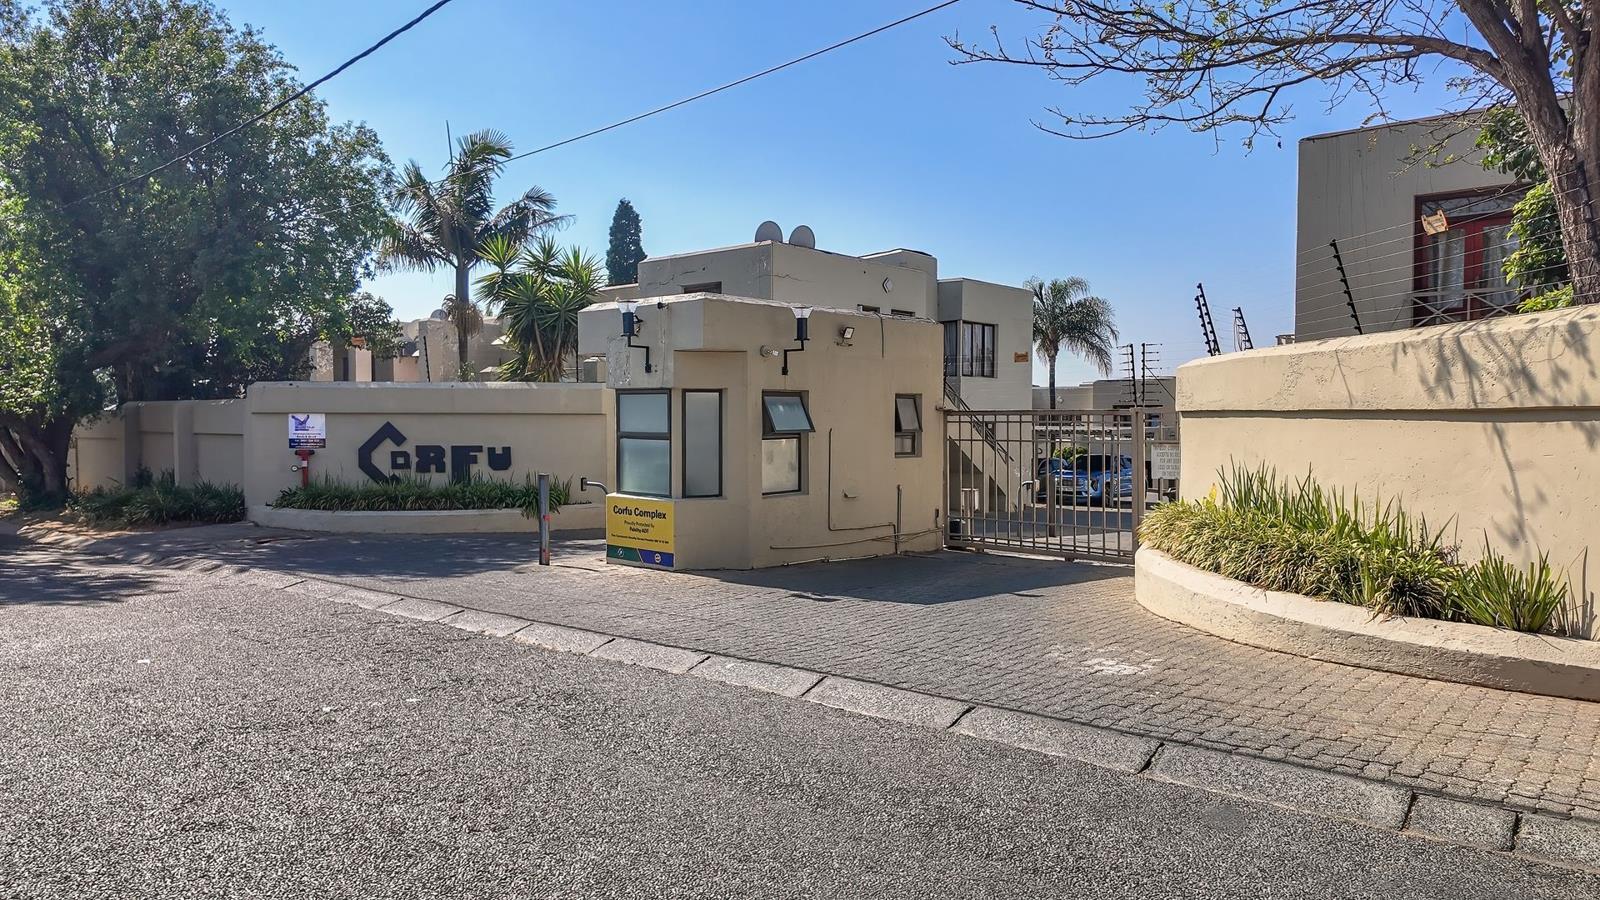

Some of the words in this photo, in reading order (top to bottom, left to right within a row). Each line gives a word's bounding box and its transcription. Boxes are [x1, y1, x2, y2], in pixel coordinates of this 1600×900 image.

[358, 421, 512, 485] CORFU
[613, 504, 633, 516] Corfu
[634, 507, 667, 520] Complex
